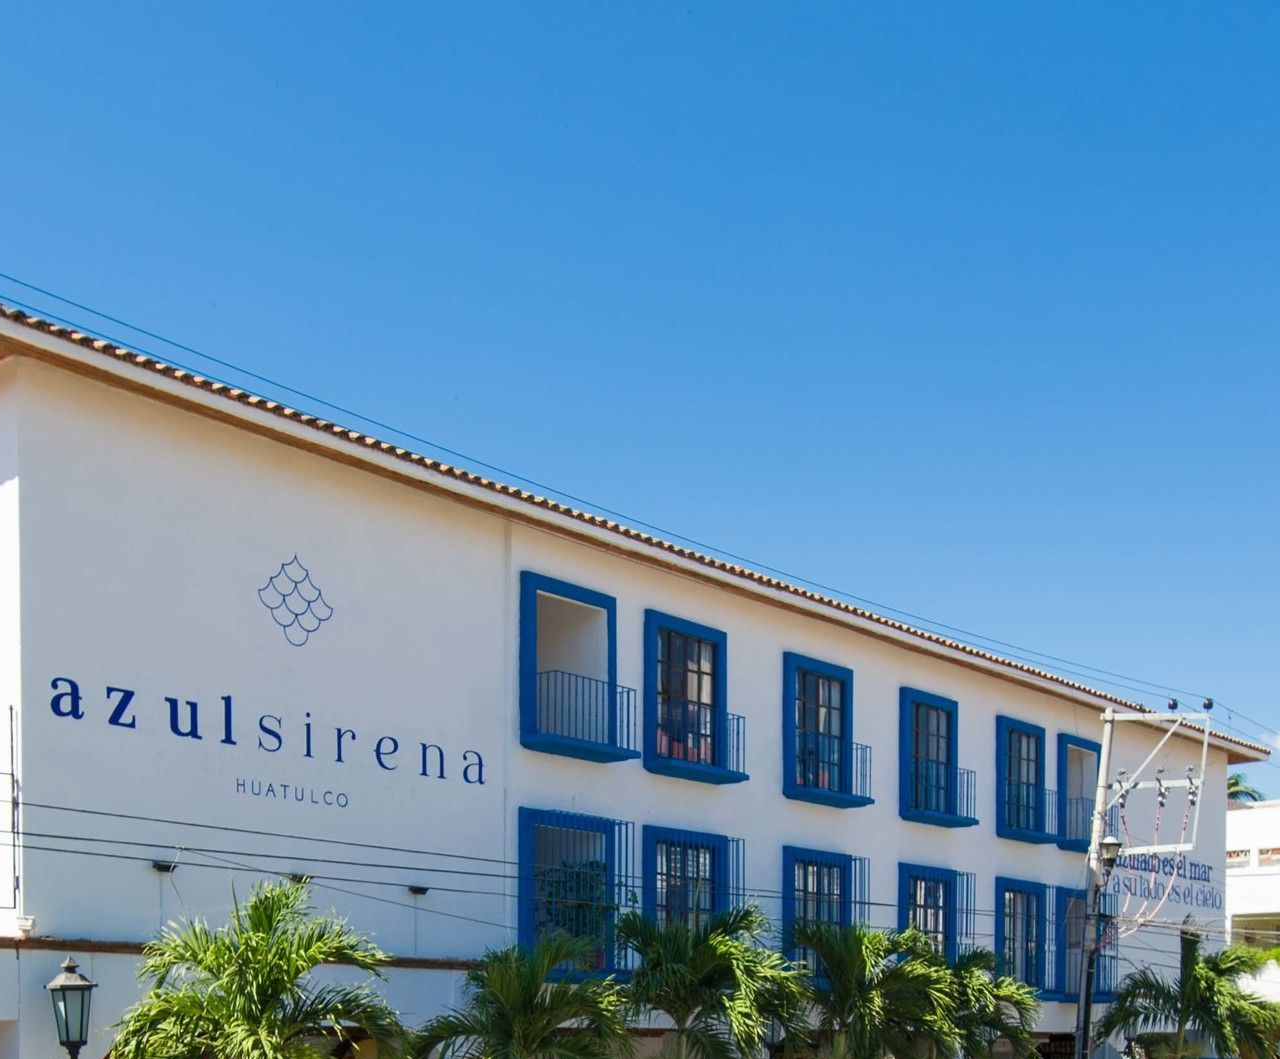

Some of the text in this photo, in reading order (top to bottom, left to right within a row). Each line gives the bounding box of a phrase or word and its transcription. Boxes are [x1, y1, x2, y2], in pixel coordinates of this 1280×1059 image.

[50, 675, 487, 787] azulsirena
[235, 777, 349, 809] HUATULCO
[1162, 857, 1175, 877] es
[1176, 855, 1187, 880] el
[1189, 862, 1213, 883] mar
[1113, 875, 1121, 894] a
[1122, 875, 1138, 897] su
[1139, 874, 1165, 901] lado
[1167, 884, 1181, 904] es
[1183, 884, 1194, 906] el
[1196, 884, 1223, 910] cielo
